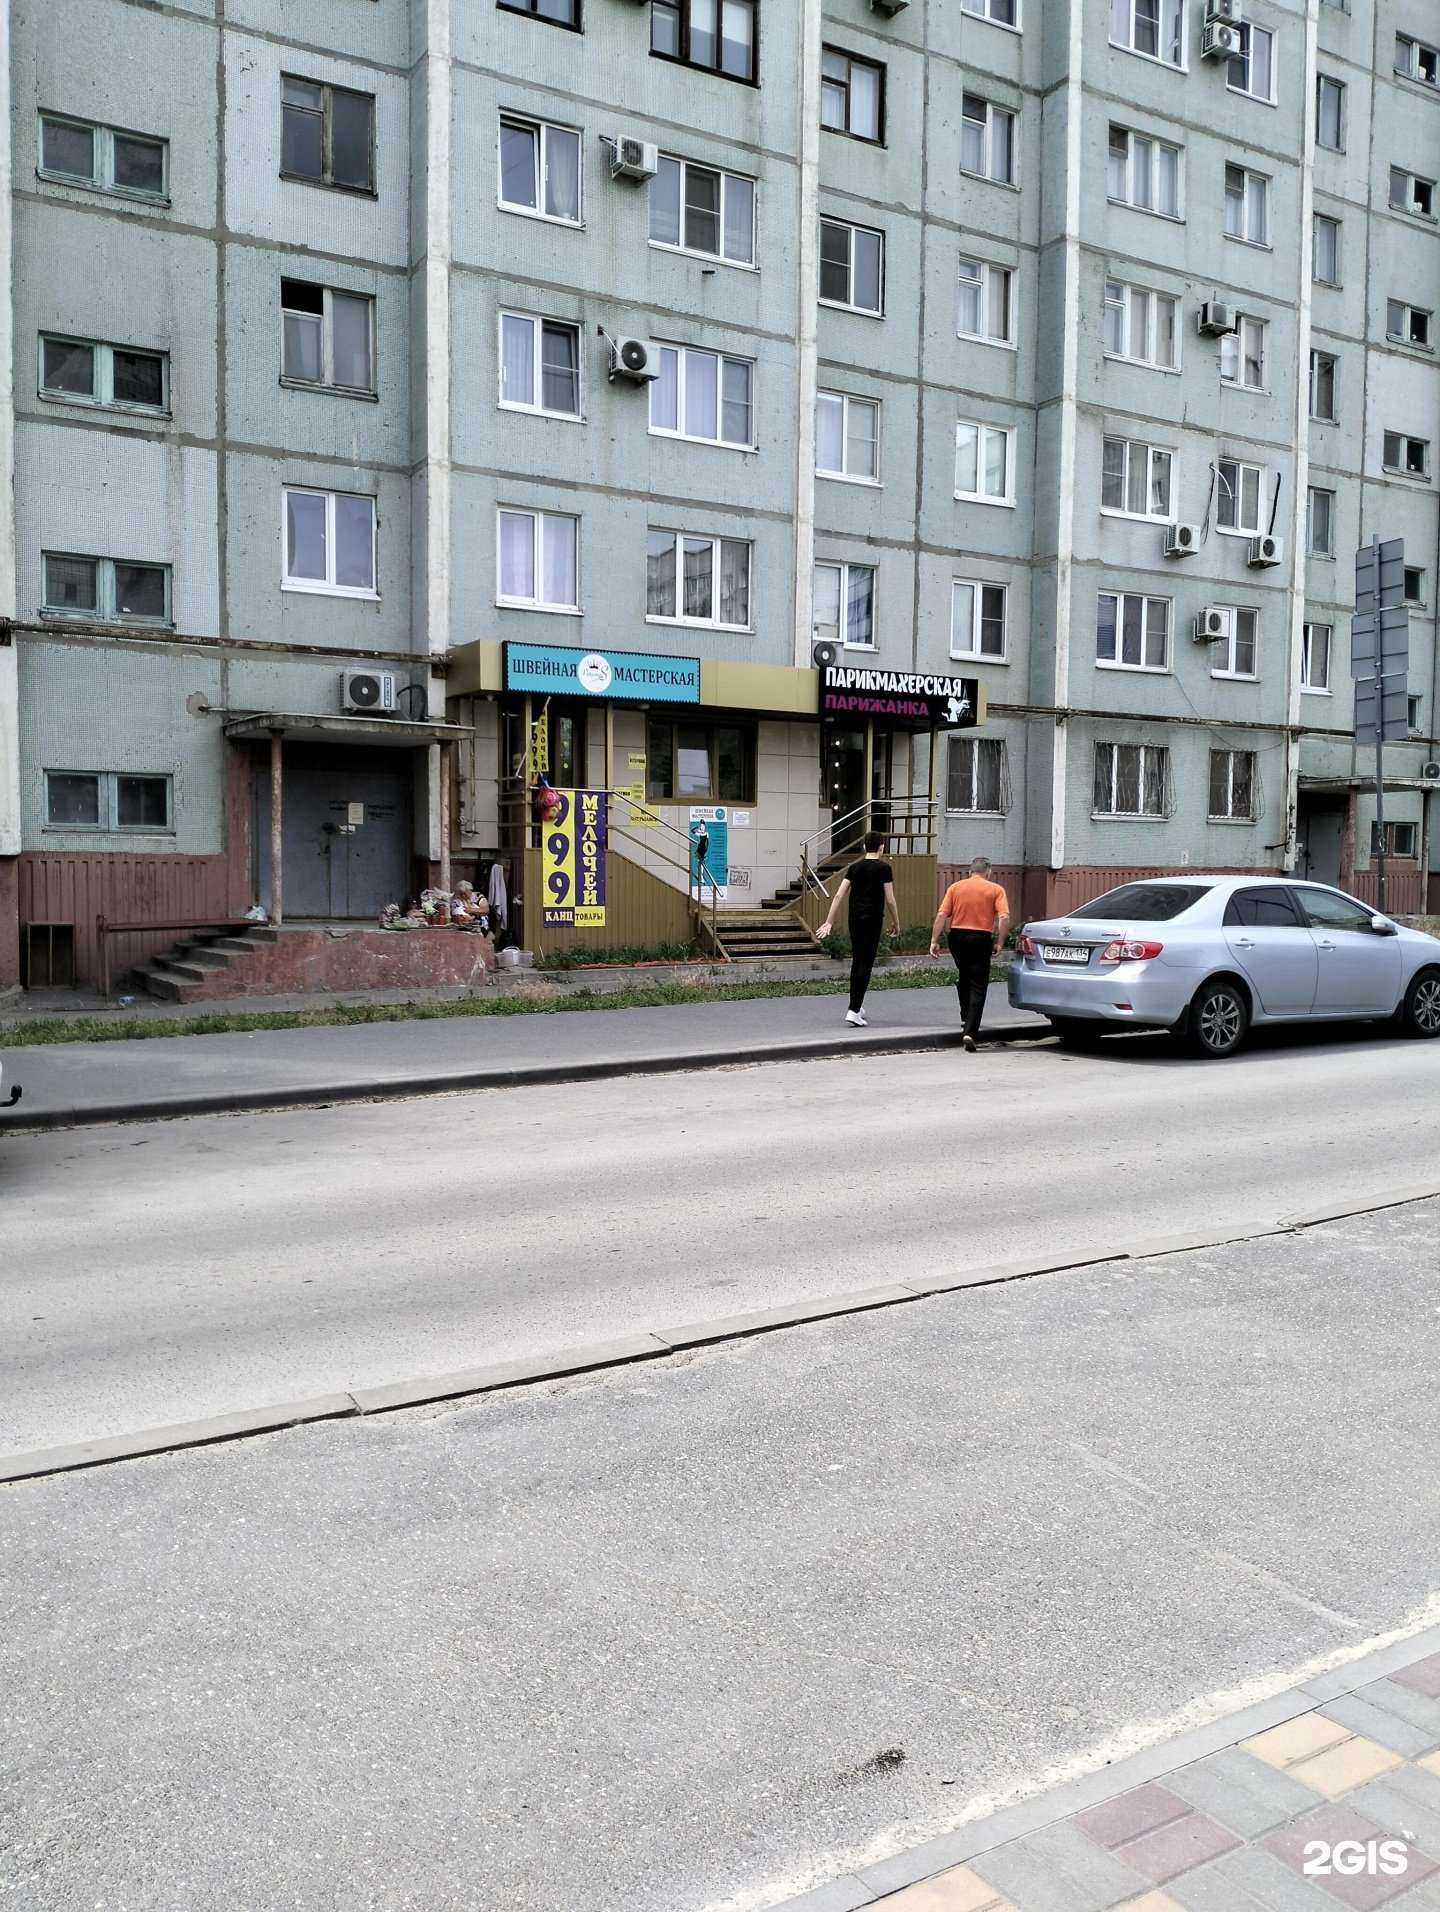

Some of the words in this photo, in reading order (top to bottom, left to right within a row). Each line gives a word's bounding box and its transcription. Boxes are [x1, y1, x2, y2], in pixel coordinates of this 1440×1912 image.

[512, 657, 577, 678] ШВЕЙНАЯ
[614, 667, 695, 687] МАСТЕРСКАЯ
[825, 666, 962, 698] ПАРИКМАХЕРСКАЯ
[825, 694, 929, 717] ПАРИЖАНКА
[581, 794, 599, 906] МЕЛОЧЕЙ
